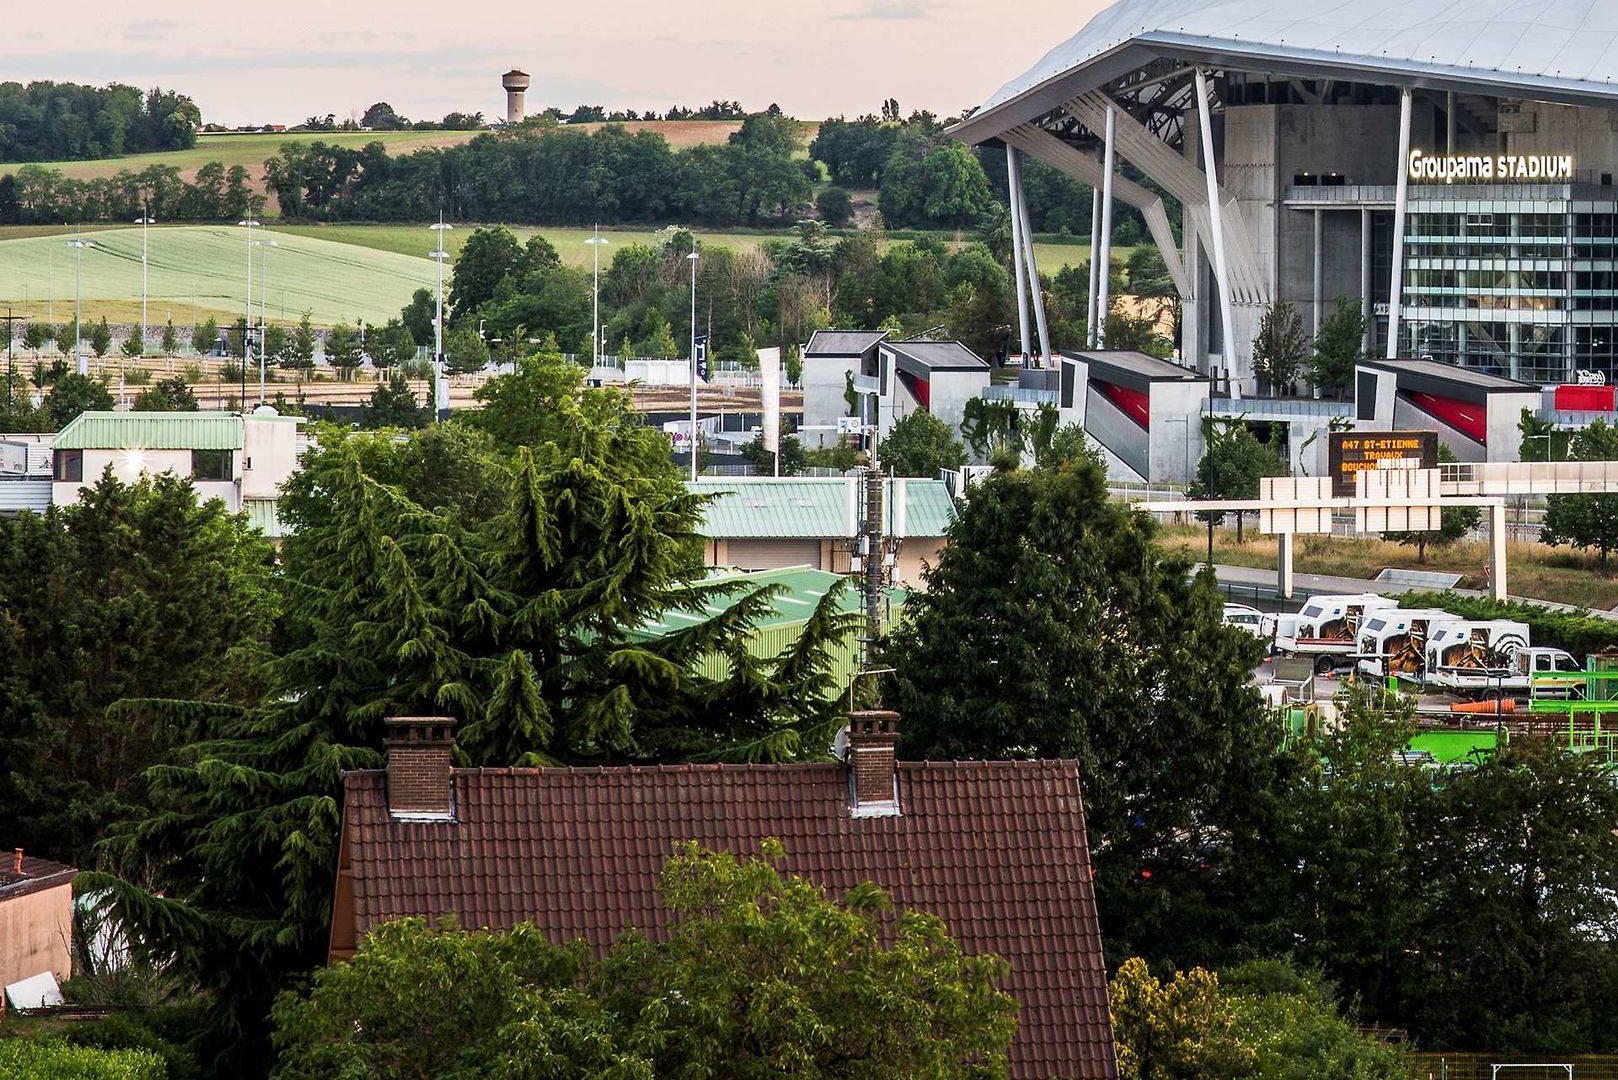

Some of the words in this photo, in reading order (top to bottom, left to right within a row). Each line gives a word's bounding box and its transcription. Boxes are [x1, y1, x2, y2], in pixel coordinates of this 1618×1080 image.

[1408, 149, 1493, 185] Groupama
[1497, 155, 1573, 178] STADIUM
[1342, 440, 1360, 449] A47
[1364, 439, 1420, 449] ST-ETIENNE
[1364, 451, 1403, 460] TRAVAUX
